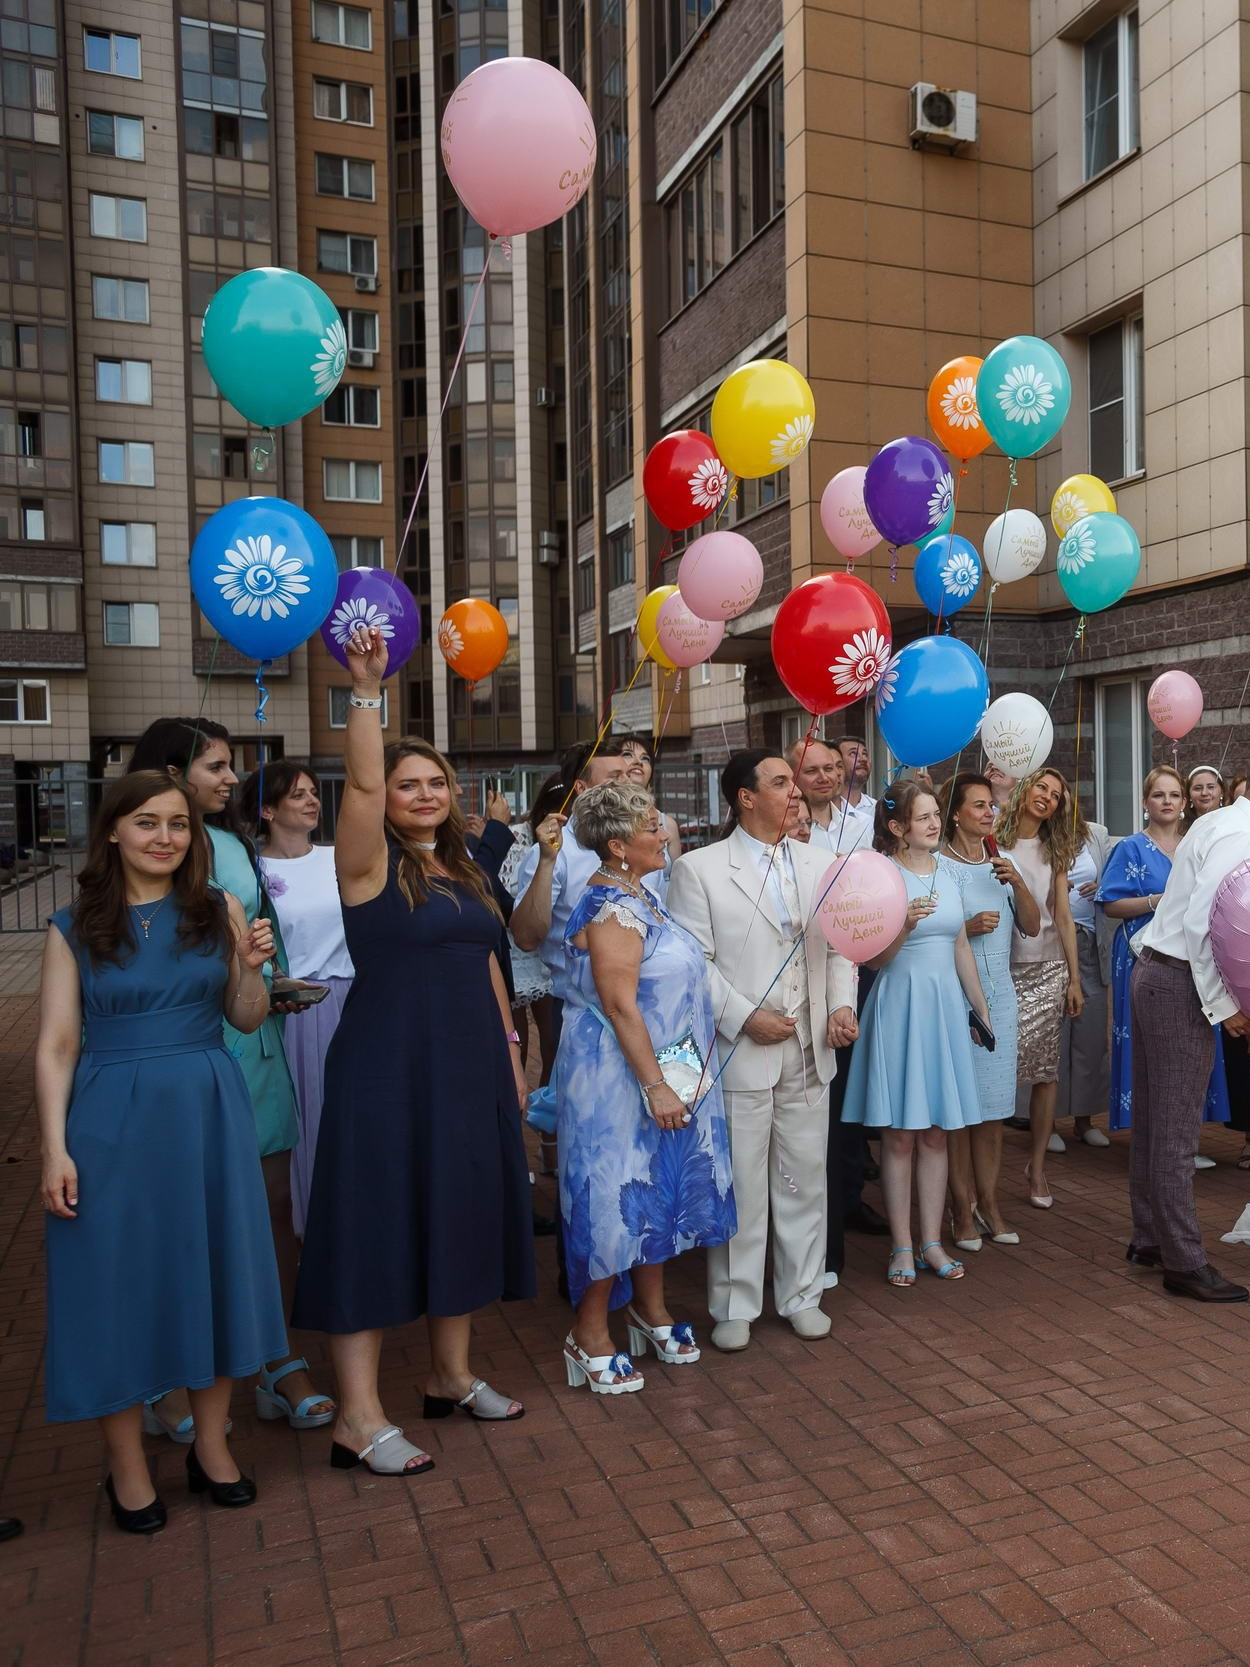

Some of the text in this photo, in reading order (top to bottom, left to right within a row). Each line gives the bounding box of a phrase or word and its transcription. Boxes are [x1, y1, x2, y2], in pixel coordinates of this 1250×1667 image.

[683, 639, 706, 649] День
[985, 736, 1013, 749] Самый
[994, 744, 1031, 760] Лучший
[822, 896, 863, 914] Самый
[833, 908, 884, 931] Лучший
[852, 925, 884, 943] День
